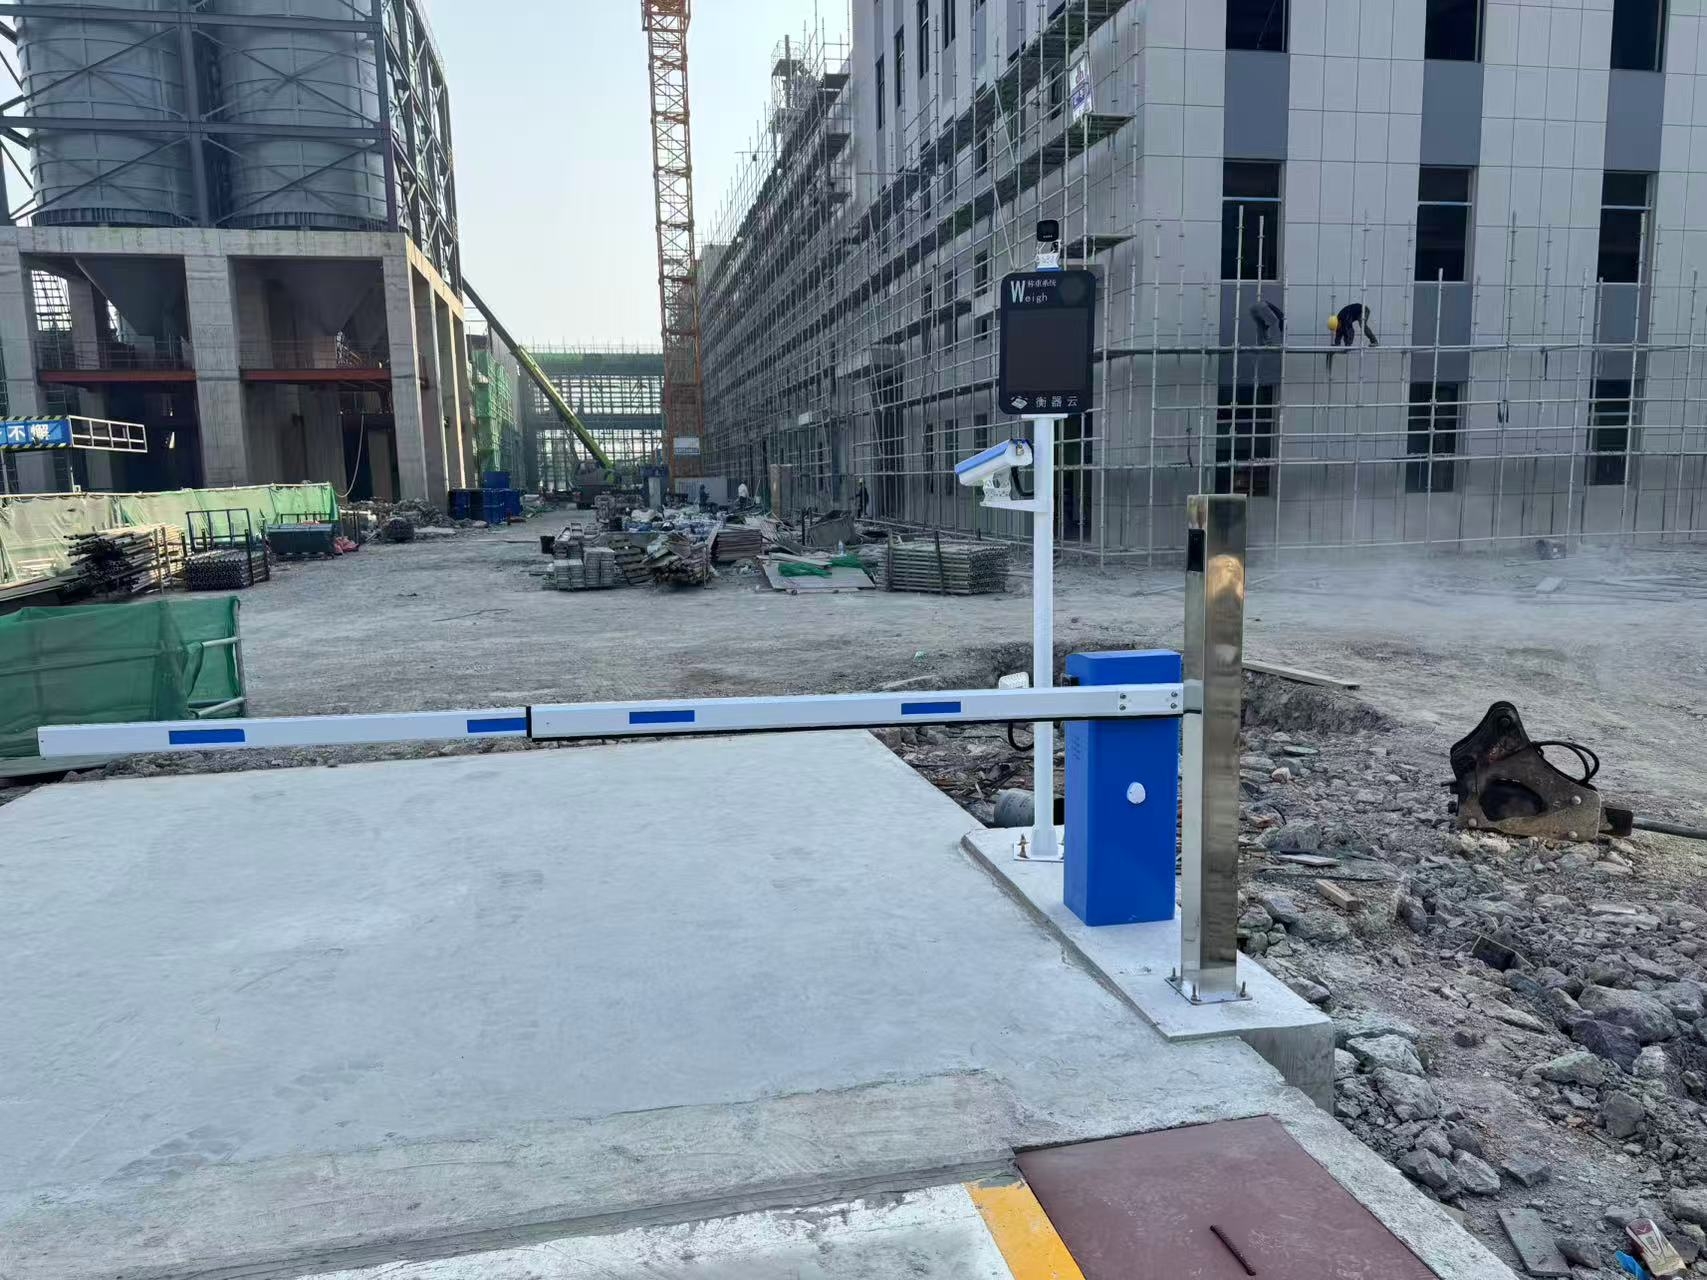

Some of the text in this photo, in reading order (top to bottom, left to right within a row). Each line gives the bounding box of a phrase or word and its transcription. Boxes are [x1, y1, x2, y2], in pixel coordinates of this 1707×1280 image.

[1010, 280, 1048, 303] Weigh
[1036, 396, 1078, 408] 衡器云
[0, 423, 50, 441] 不懈
